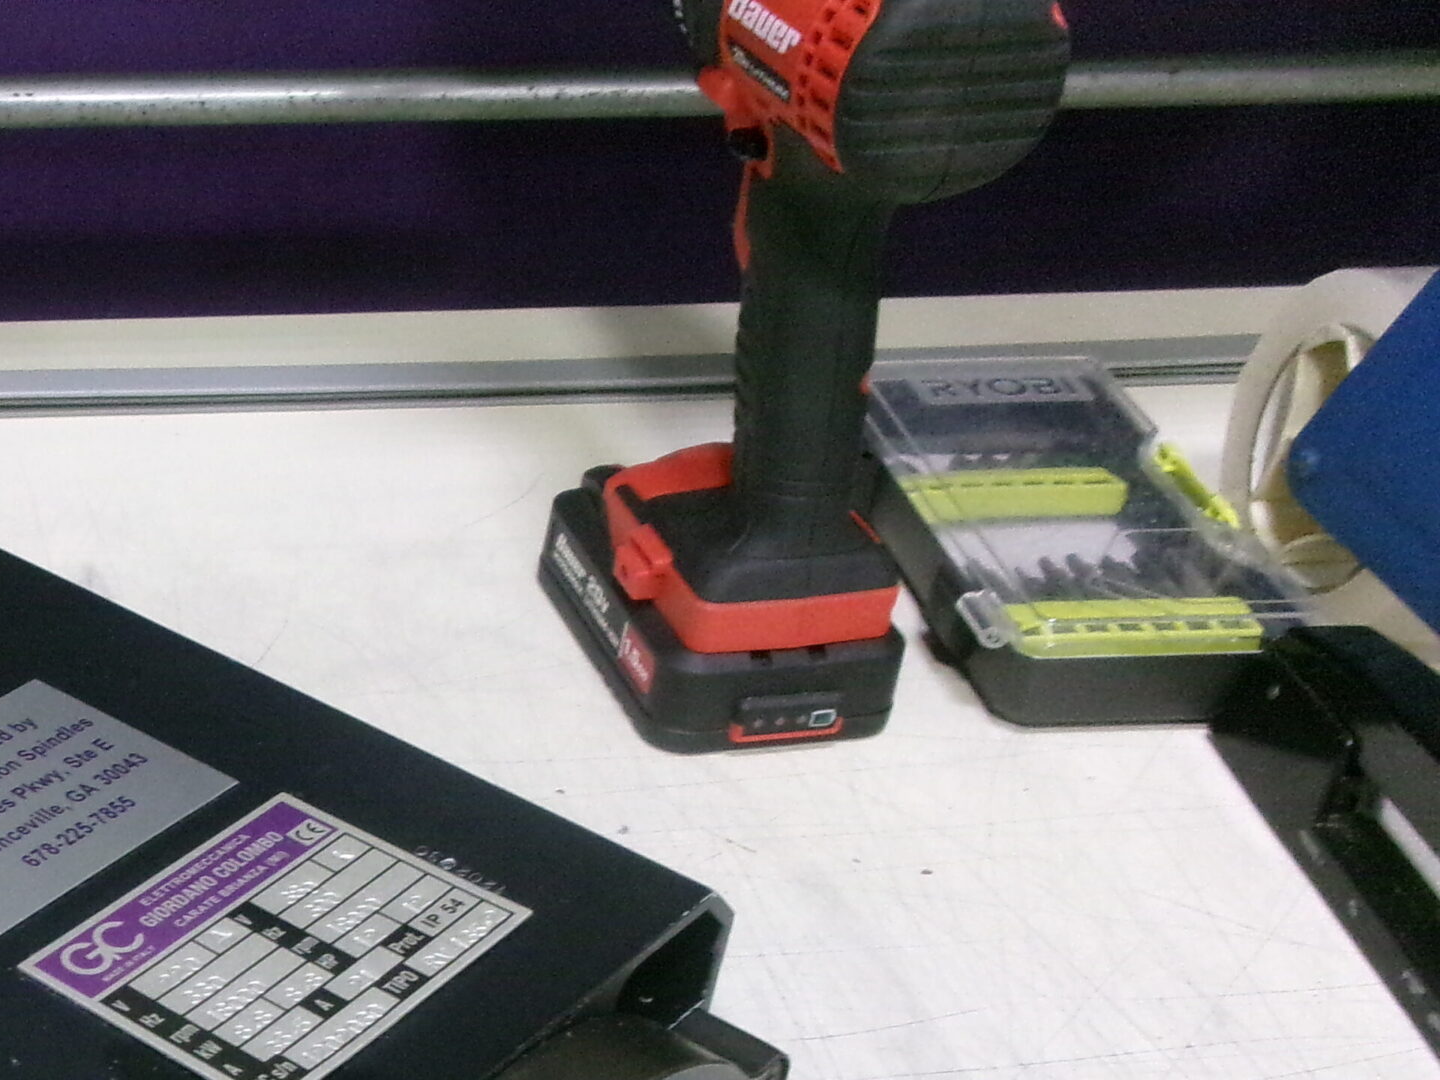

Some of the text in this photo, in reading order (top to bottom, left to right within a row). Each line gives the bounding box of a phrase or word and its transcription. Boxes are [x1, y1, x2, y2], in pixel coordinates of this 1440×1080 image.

[921, 377, 1076, 397] RYOBI
[7, 717, 39, 733] by
[16, 718, 94, 761] Spindles
[63, 749, 99, 769] Ste
[91, 738, 115, 751] E
[65, 783, 100, 802] GA
[93, 752, 148, 786] 30043
[21, 795, 137, 867] 678-225-7855
[138, 834, 251, 907] ELETTROMECCANICA
[139, 831, 284, 927] GIORDANO COLOMBO
[173, 895, 222, 927] CARATE
[217, 865, 269, 898] BRIANZA
[59, 920, 145, 976] GC
[111, 999, 131, 1012] V
[233, 914, 253, 925] V
[139, 1013, 165, 1028] Hz
[261, 926, 287, 941] Hz
[169, 1023, 200, 1044] rpm
[290, 936, 320, 955] rpm
[193, 1040, 223, 1060] kW
[314, 953, 339, 970] HP
[223, 1063, 243, 1076] A
[314, 999, 334, 1011] A
[387, 932, 425, 954] Prot.
[420, 913, 440, 929] IP
[439, 898, 466, 914] 54
[271, 1061, 298, 1080] s/n
[381, 970, 419, 994] TIPO
